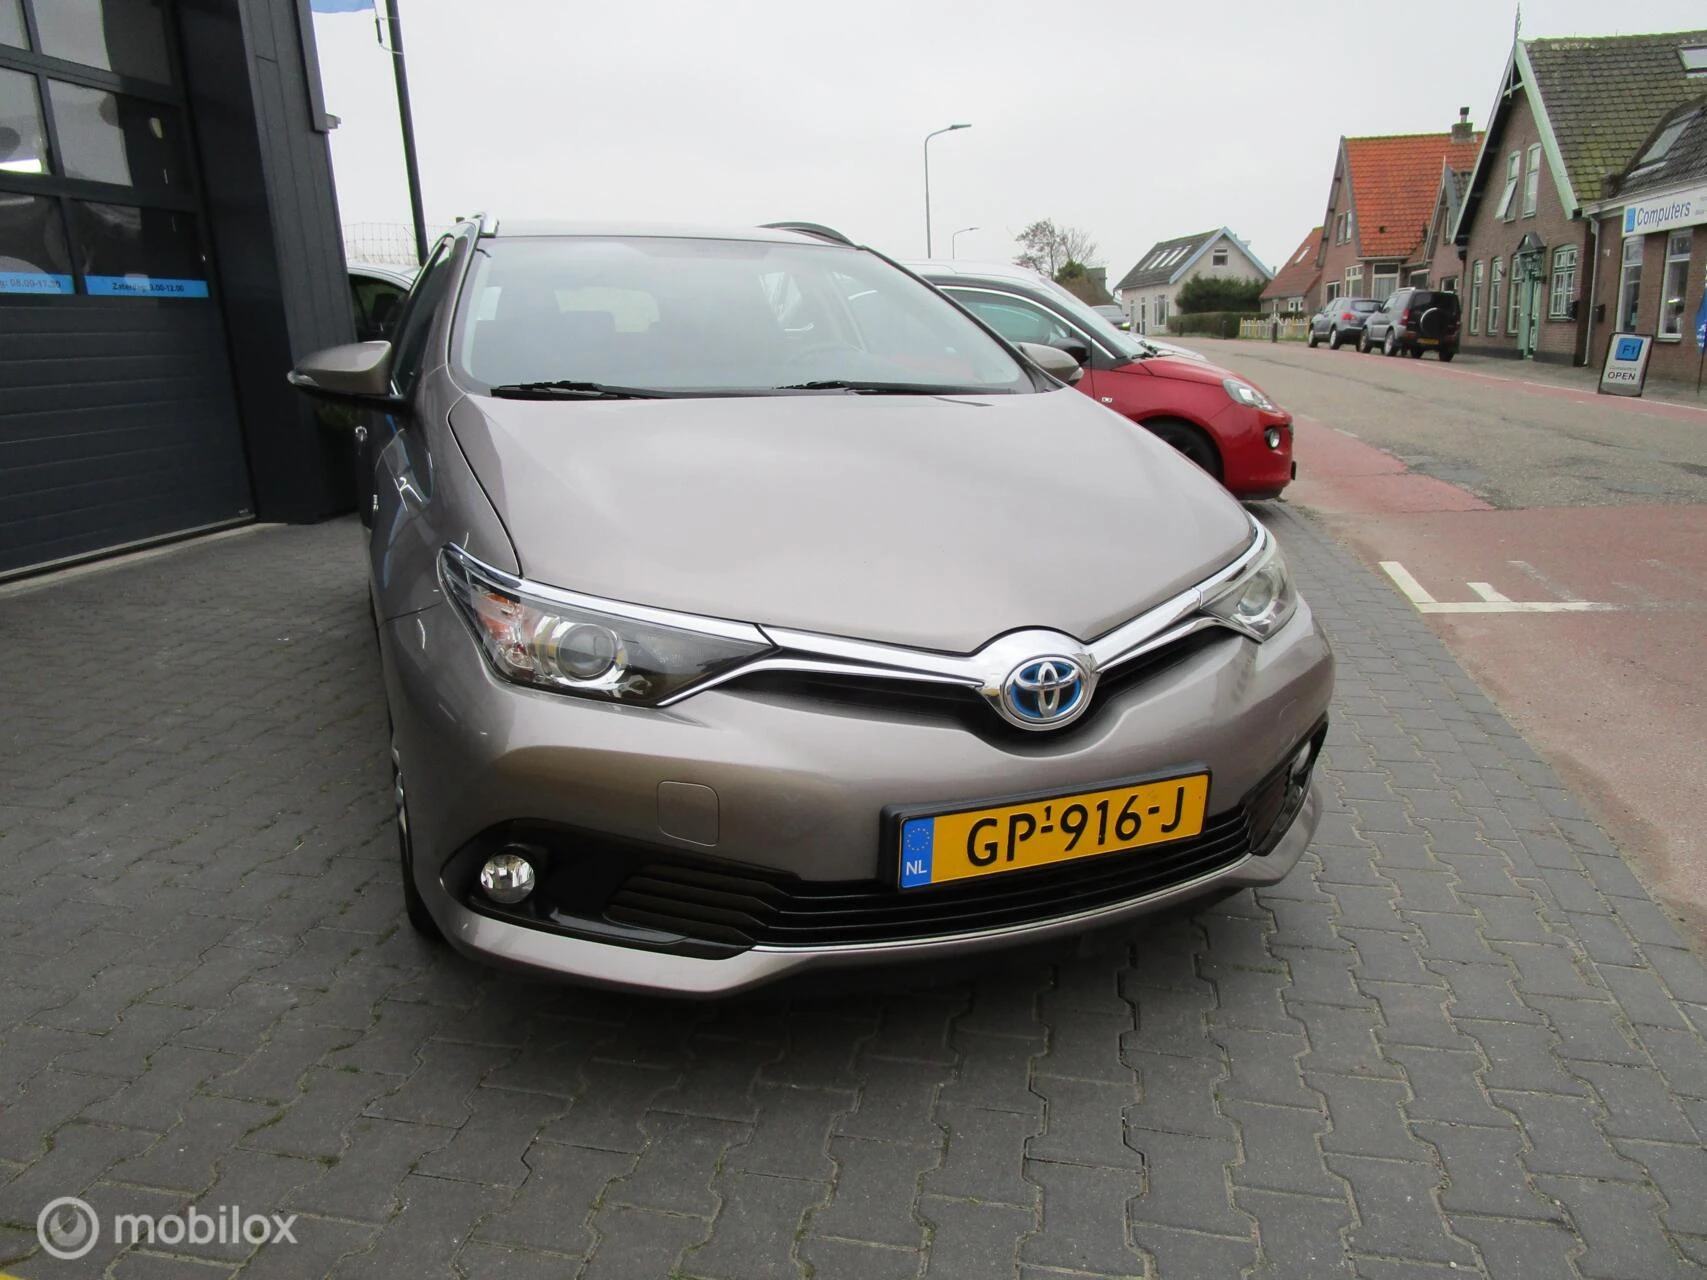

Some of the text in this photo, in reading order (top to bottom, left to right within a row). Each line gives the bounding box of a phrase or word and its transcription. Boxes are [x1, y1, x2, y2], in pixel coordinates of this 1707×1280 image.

[1636, 201, 1691, 228] Computers
[1608, 371, 1636, 380] OPEN
[905, 861, 928, 876] NL
